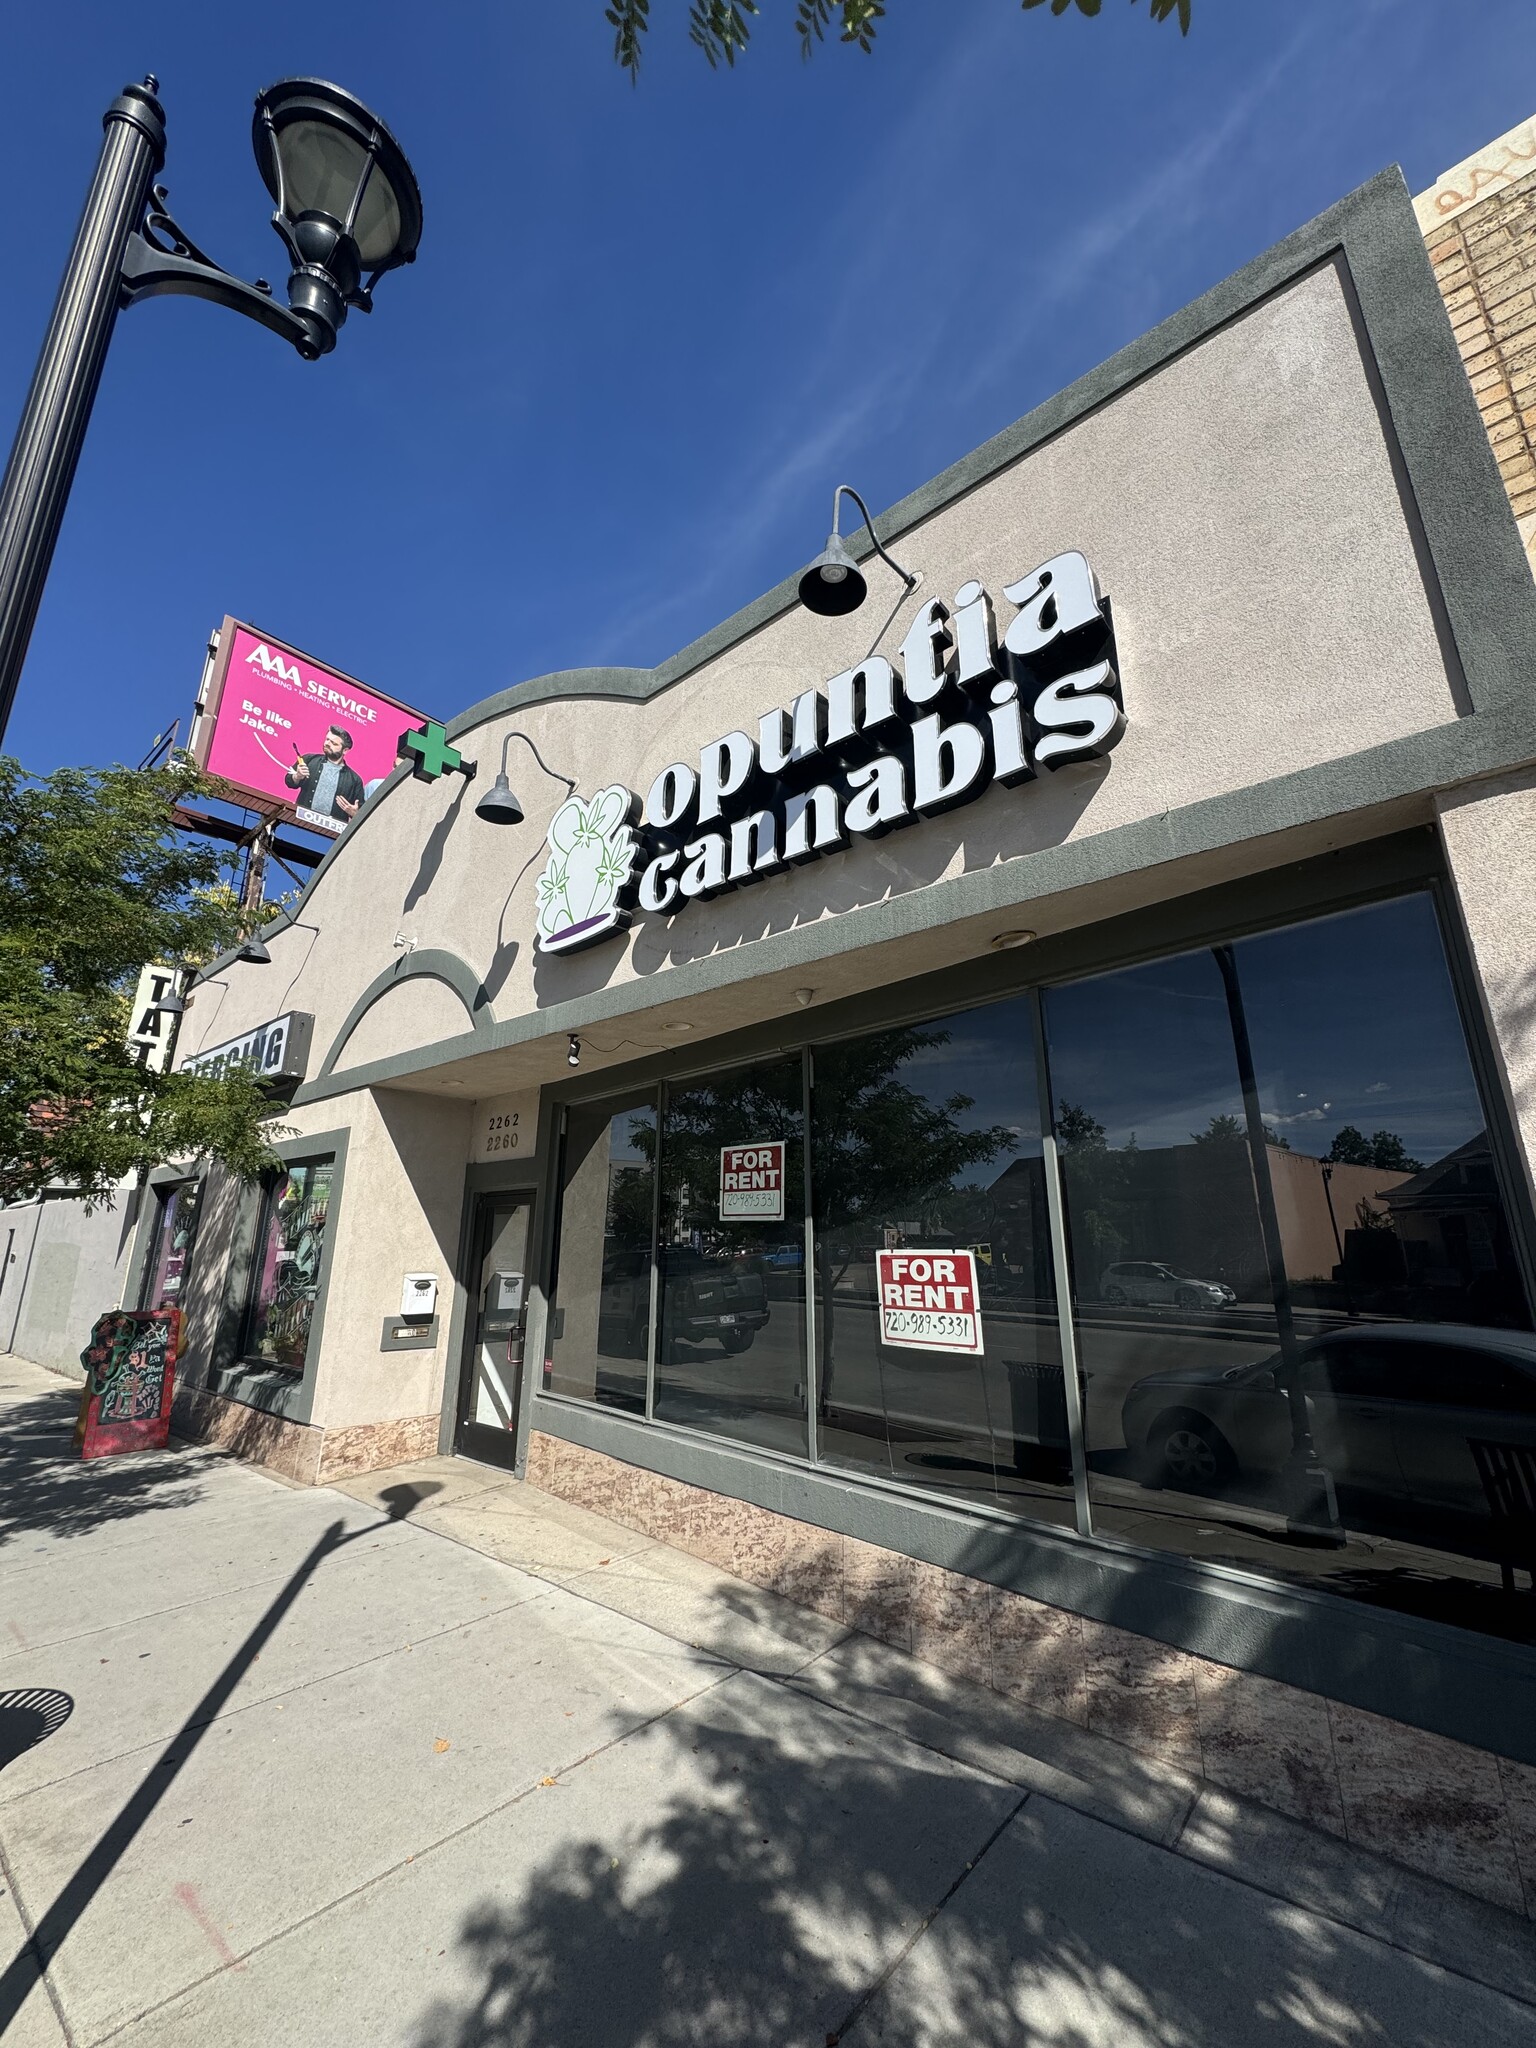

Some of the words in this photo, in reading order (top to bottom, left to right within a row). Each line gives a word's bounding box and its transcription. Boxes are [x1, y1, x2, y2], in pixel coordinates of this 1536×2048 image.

[245, 643, 302, 688] AAA
[307, 680, 378, 723] SERVICE
[645, 550, 1102, 829] opuntia
[252, 667, 293, 691] PLUMBING
[299, 689, 331, 709] HEATING
[335, 707, 368, 726] ELECTRIC
[239, 713, 279, 737] Jake.
[242, 700, 262, 716] Be
[265, 709, 292, 729] like
[638, 659, 1125, 915] cannabis
[303, 811, 347, 832] OUTFR
[184, 1027, 284, 1080] IERCING
[488, 1112, 519, 1131] 2262
[486, 1132, 519, 1152] 2260
[731, 1150, 773, 1170] FOR
[724, 1169, 780, 1190] RENT
[891, 1258, 956, 1282] FOR
[884, 1283, 969, 1310] RENT
